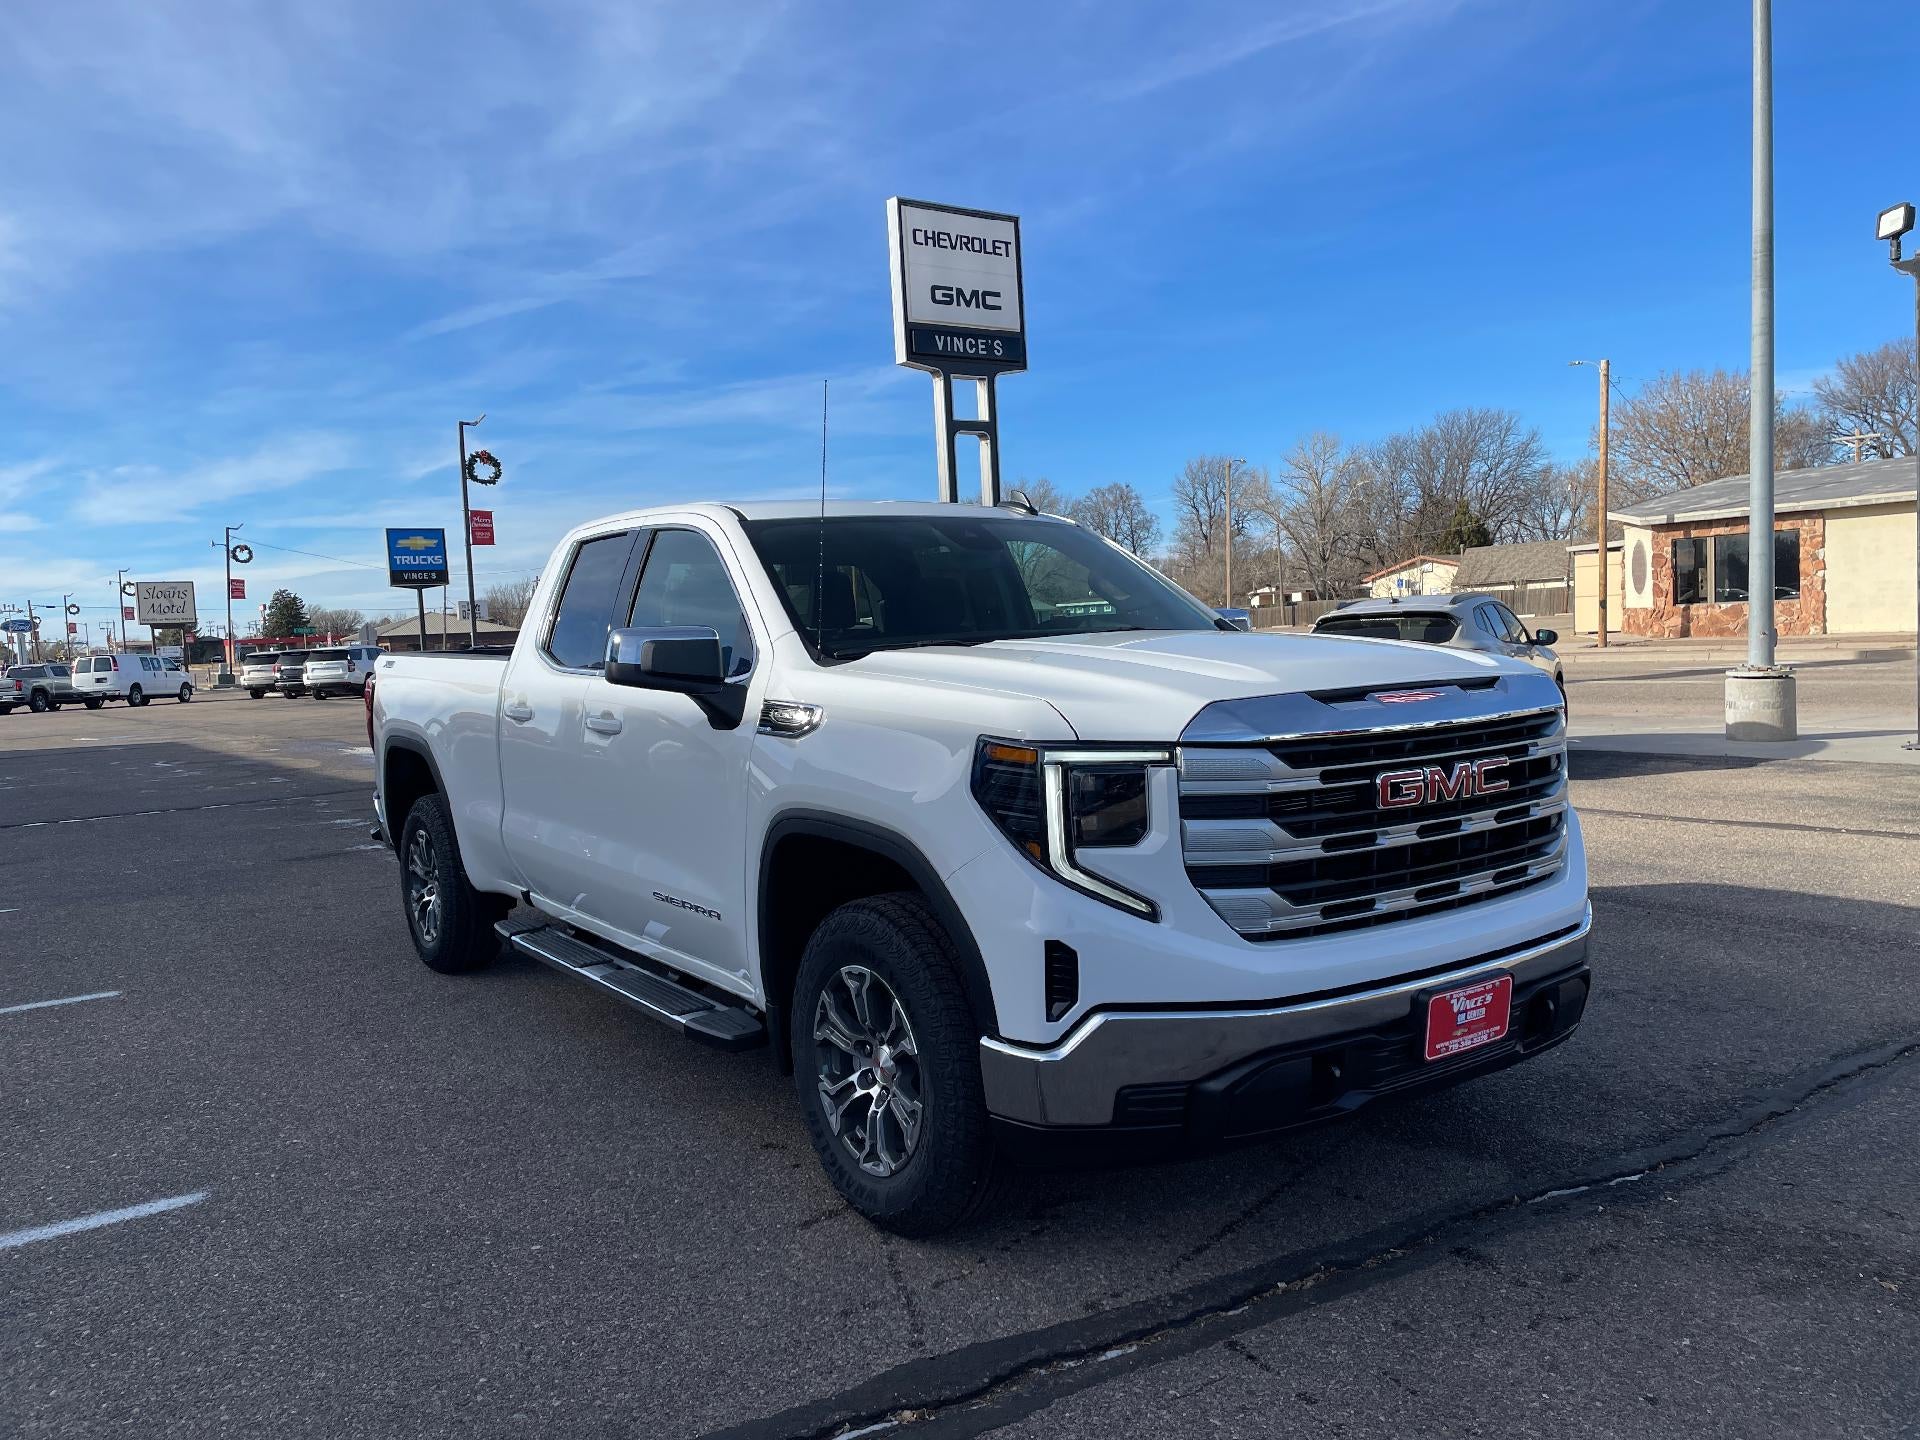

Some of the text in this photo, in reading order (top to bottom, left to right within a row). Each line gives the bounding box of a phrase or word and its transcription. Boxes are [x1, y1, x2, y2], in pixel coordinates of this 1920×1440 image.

[912, 228, 1012, 258] CHEVROLET
[930, 284, 1003, 311] GMC
[934, 334, 1004, 357] VINCE'S
[393, 555, 443, 565] TRUCKS
[403, 572, 437, 580] VINCE'S
[143, 585, 188, 600] Sloans
[146, 600, 186, 615] Motel
[8, 622, 31, 631] Ford
[1376, 756, 1510, 810] GMC
[652, 891, 721, 921] SIERRA
[1450, 993, 1494, 1013] VINCE'S
